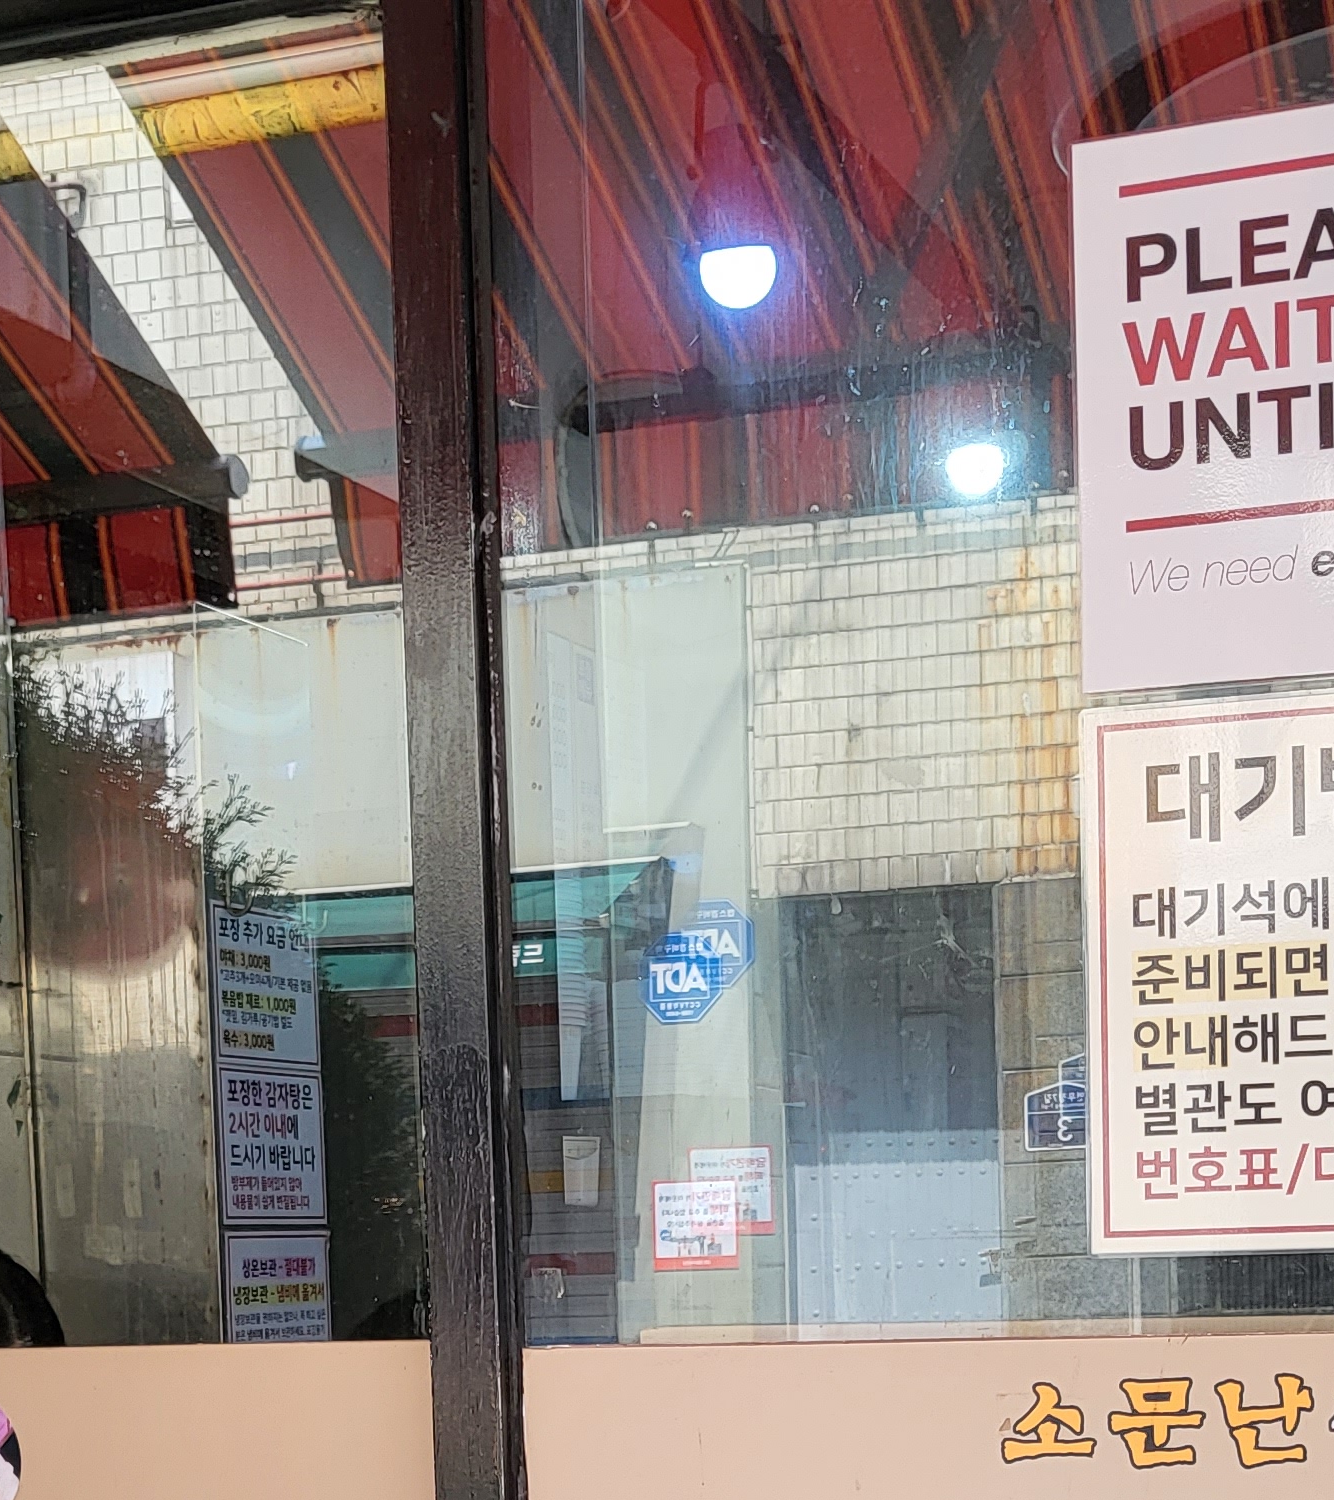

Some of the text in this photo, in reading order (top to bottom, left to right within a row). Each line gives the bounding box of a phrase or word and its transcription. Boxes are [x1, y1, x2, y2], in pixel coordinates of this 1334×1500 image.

[1128, 558, 1197, 596] We
[1202, 545, 1298, 588] need
[1132, 876, 1331, 940] 대기석에
[218, 917, 240, 943] 포장
[243, 919, 264, 946] 추가
[266, 925, 286, 950] 요금
[240, 953, 272, 973] 3,000원
[1131, 944, 1331, 1006] 준비되면
[266, 997, 297, 1016] 1,000원
[222, 1030, 276, 1052] 육수: 3,000원
[227, 1079, 314, 1110] 포장한 감자탕은
[1133, 1076, 1284, 1139] 별관도
[228, 1112, 299, 1140] 2시간 이내에
[230, 1143, 316, 1172] 드시기 바랍니다
[231, 1176, 260, 1192] 방부제가
[242, 1258, 278, 1279] 상온보관
[284, 1257, 316, 1277] 절대불가
[233, 1285, 269, 1306] 냉장보관
[1000, 1373, 1316, 1471] 소문난
